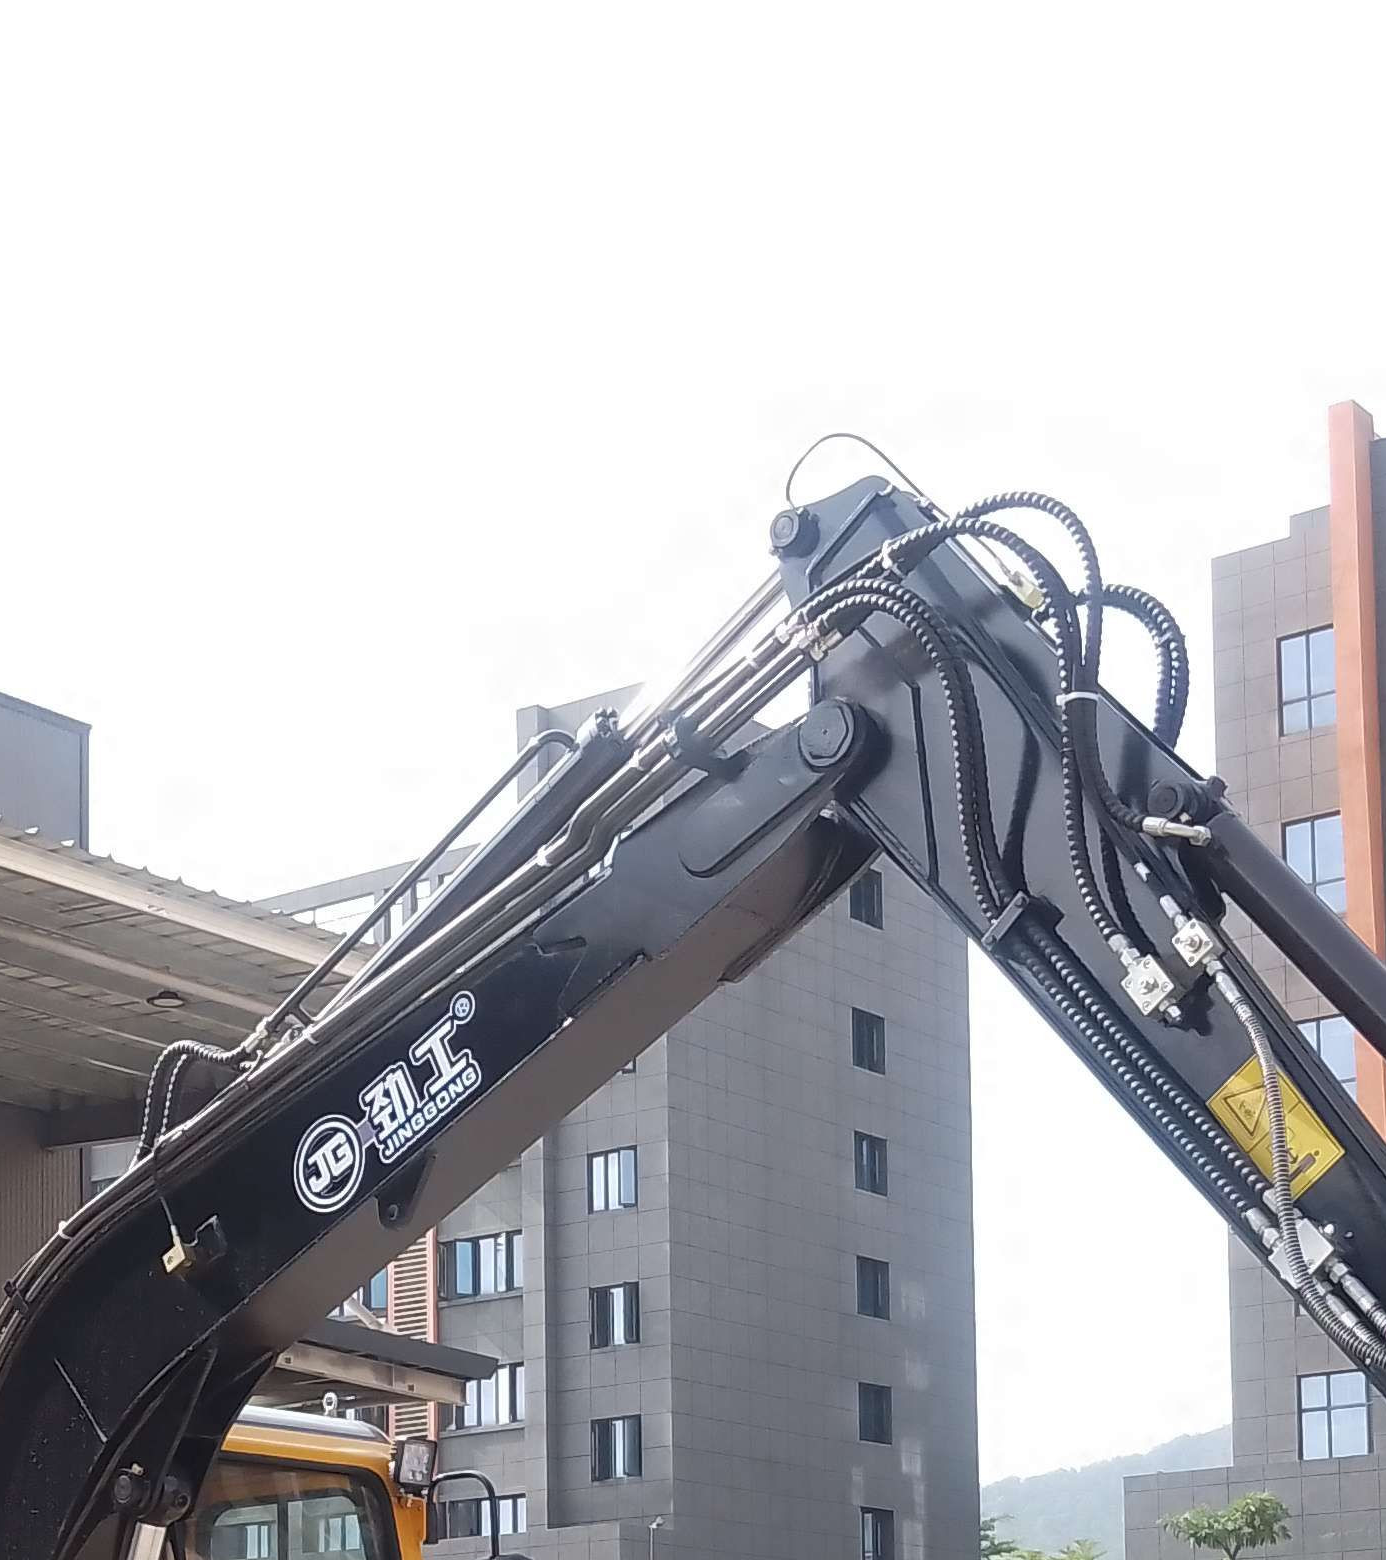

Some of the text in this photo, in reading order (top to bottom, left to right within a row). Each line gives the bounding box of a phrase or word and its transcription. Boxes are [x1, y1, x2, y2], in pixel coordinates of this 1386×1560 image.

[363, 1018, 467, 1141] 劲工
[384, 1067, 478, 1156] JINGGONG
[306, 1131, 355, 1194] JG
